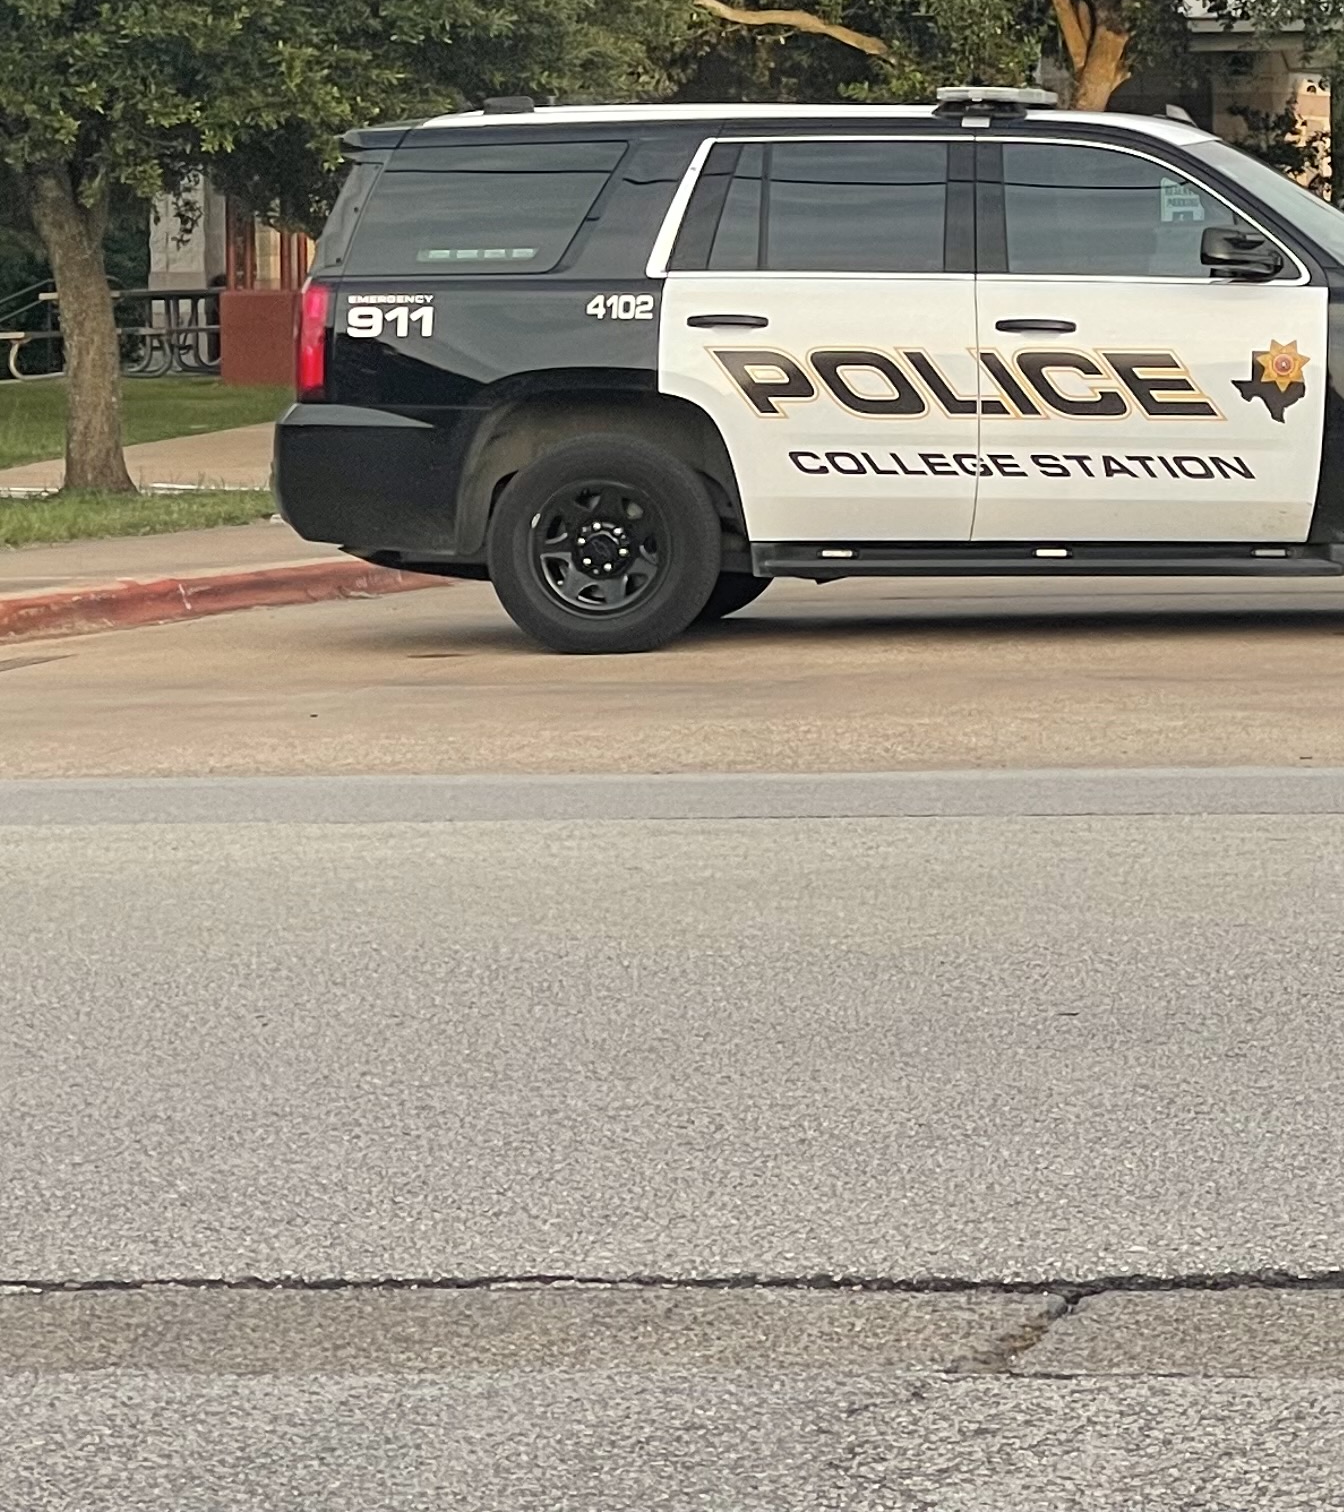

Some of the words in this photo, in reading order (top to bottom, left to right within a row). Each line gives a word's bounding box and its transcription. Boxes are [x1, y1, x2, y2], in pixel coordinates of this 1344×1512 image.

[347, 294, 434, 304] EMERGENCY
[586, 294, 654, 320] 4102
[346, 306, 435, 338] 911
[706, 347, 1226, 421] POLICE
[787, 450, 1029, 478] COLLEGE
[1031, 453, 1256, 480] STATION
